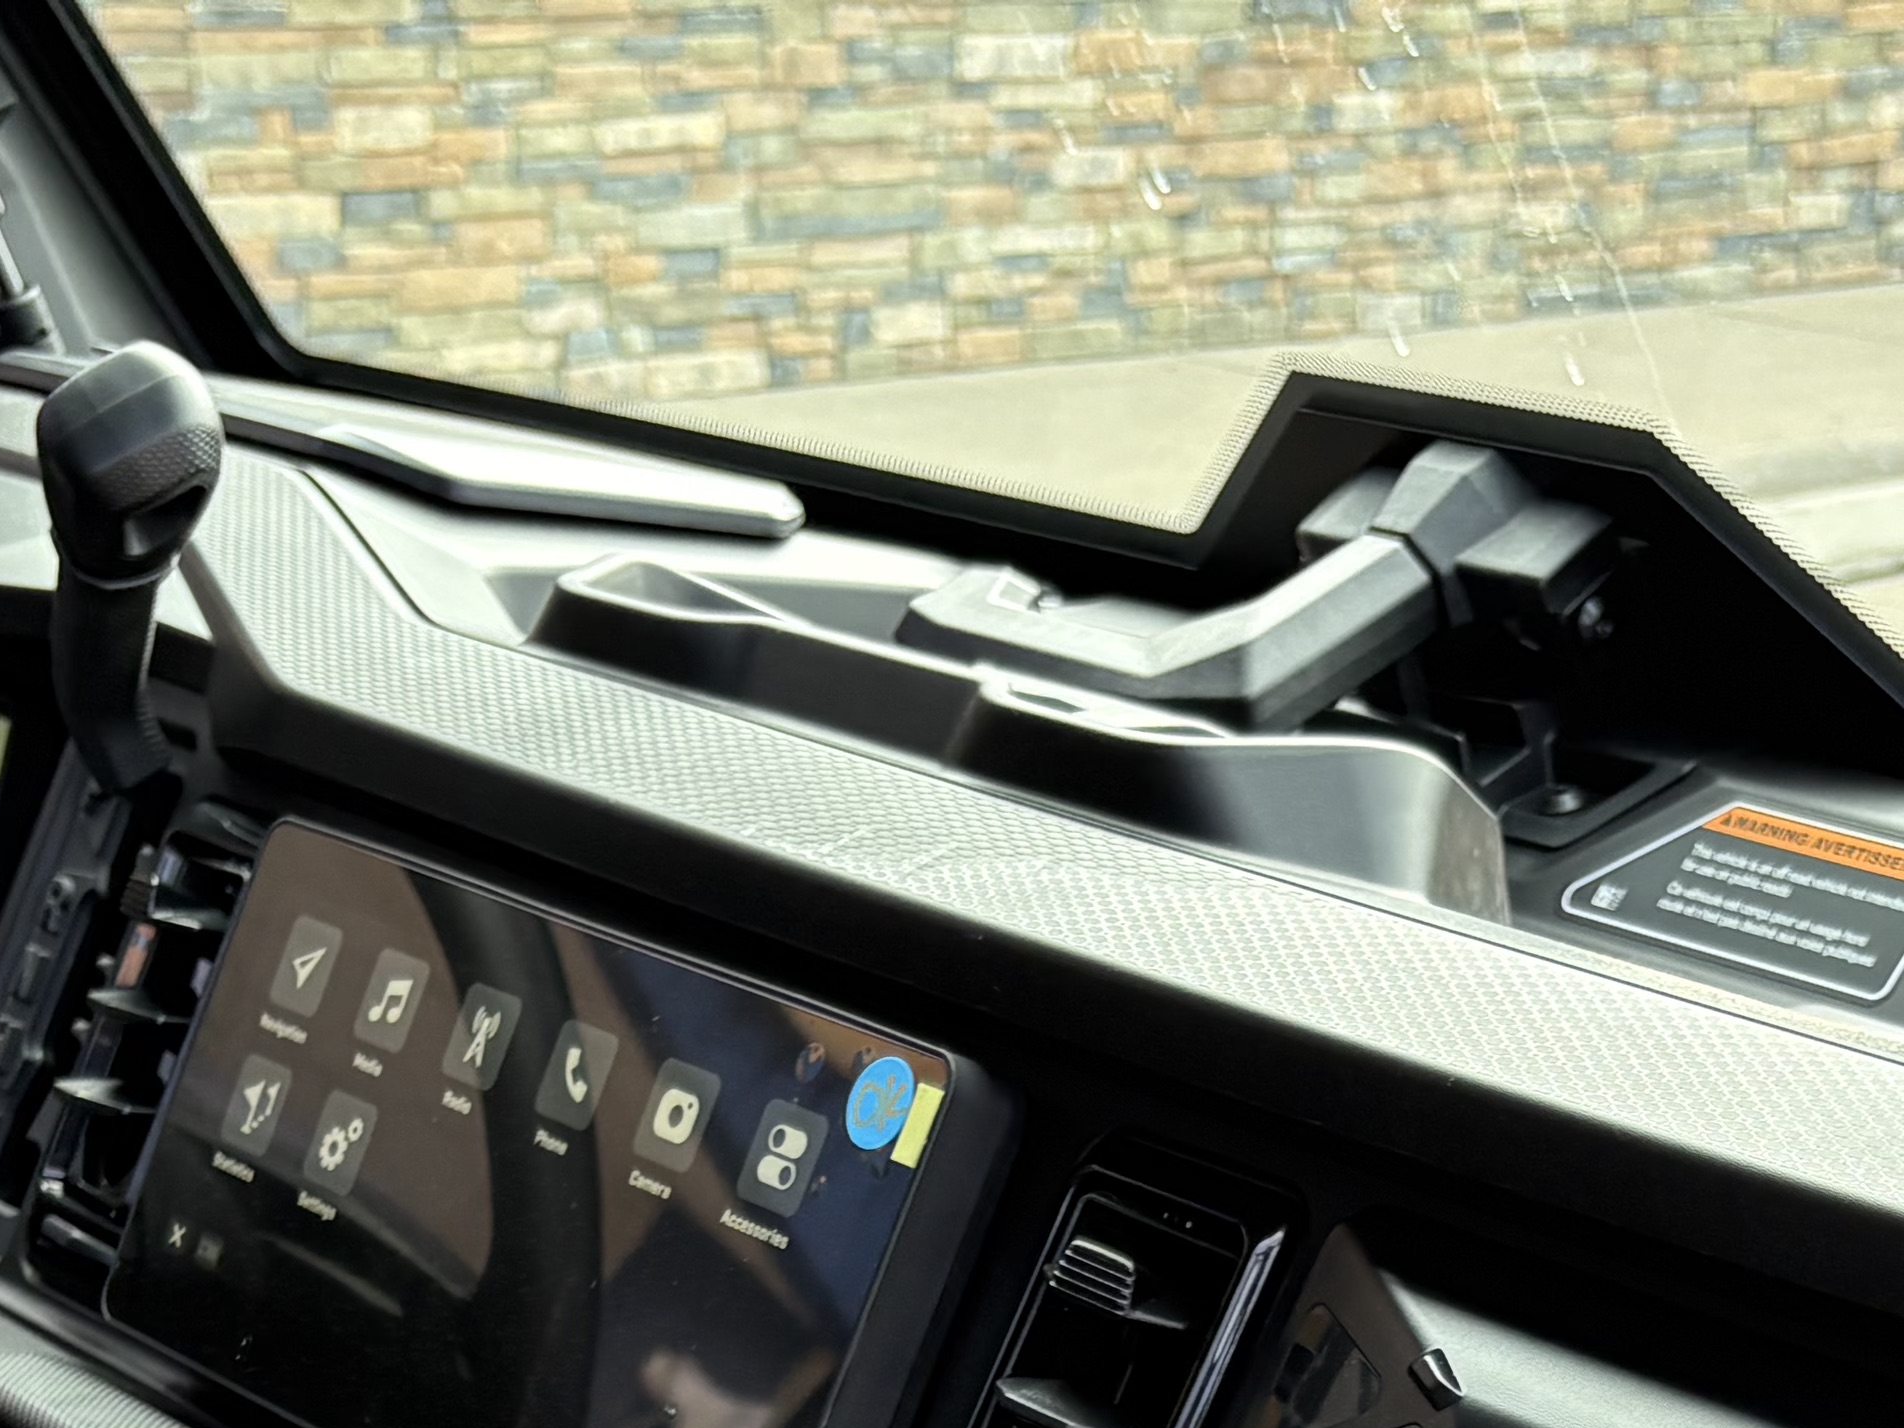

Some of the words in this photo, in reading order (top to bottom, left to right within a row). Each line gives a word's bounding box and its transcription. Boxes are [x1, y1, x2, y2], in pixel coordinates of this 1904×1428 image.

[533, 1128, 569, 1156] Phone
[628, 1169, 673, 1200] Camera
[719, 1208, 791, 1251] Accessories
